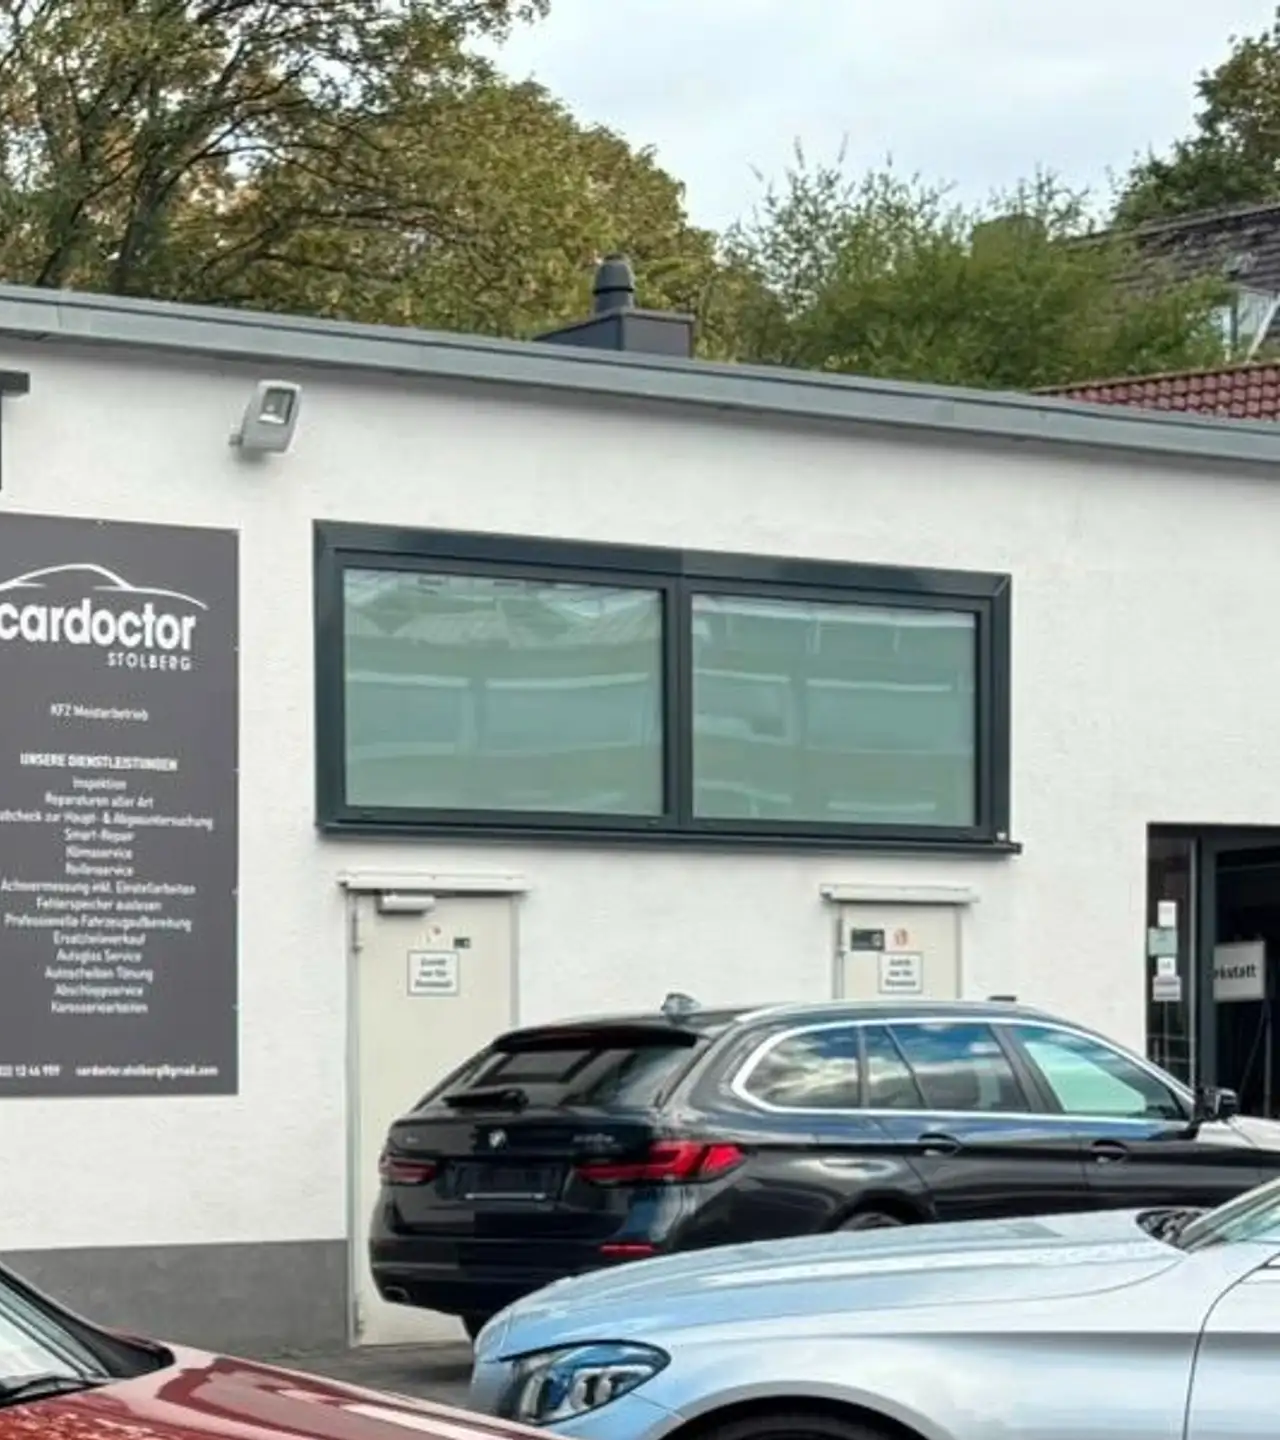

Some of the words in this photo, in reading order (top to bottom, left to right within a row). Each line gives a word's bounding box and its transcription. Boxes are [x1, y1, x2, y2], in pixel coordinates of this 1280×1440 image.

[107, 652, 192, 671] STOLBERG
[50, 703, 71, 717] KFZ
[20, 753, 66, 768] UNSERE
[68, 754, 178, 772] DIENSTLEISTUNGEN
[73, 777, 127, 791] Inspektion
[45, 793, 109, 807] Reparaturen
[111, 796, 134, 808] aller
[137, 796, 154, 809] Art
[66, 846, 133, 860] Klimaservice
[66, 862, 134, 876] Reifenservice
